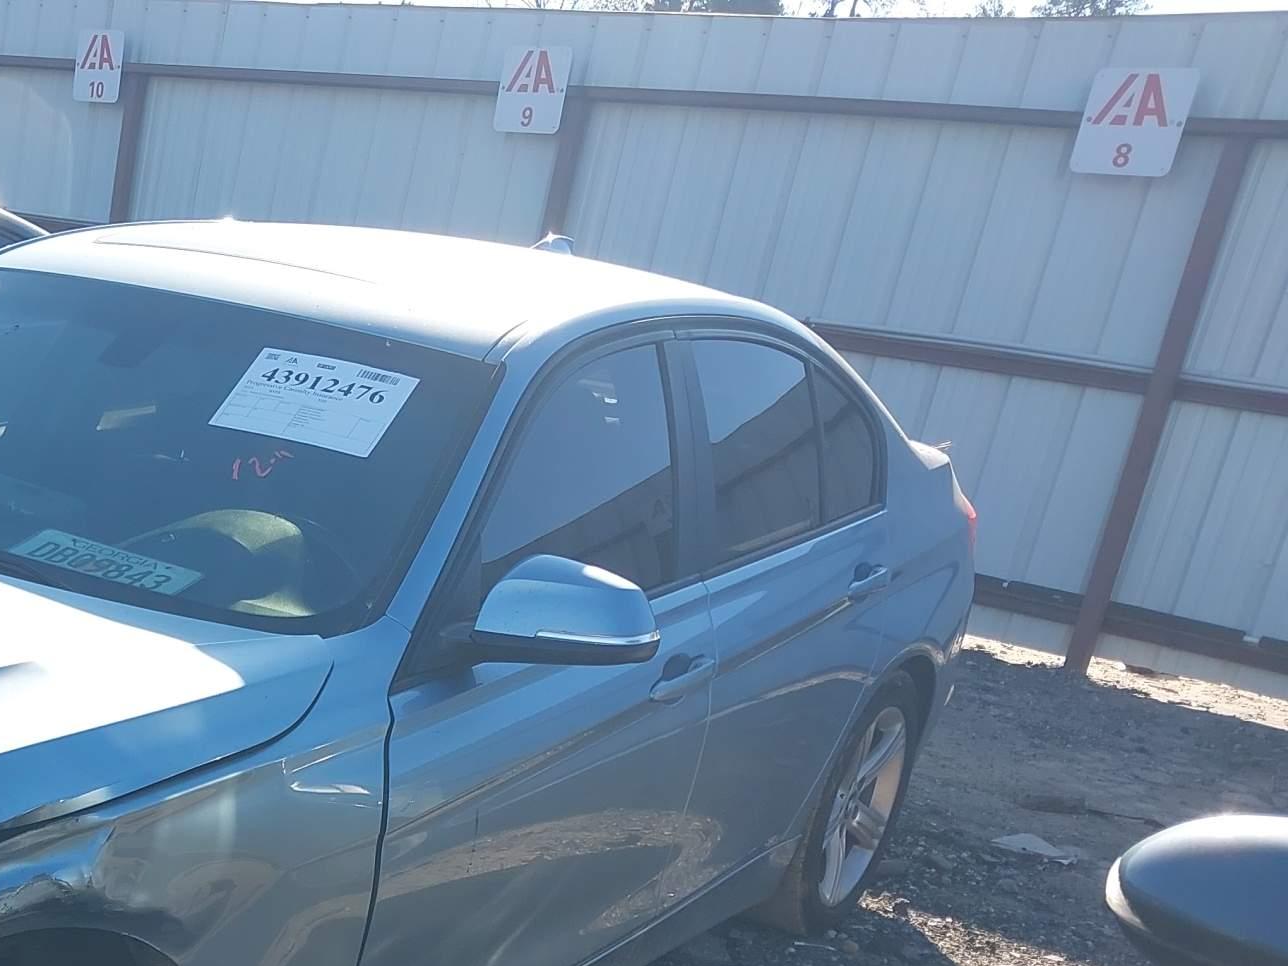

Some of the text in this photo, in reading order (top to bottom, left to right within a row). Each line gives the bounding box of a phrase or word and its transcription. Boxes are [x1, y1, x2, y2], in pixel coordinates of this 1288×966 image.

[89, 81, 105, 98] 10
[520, 106, 534, 128] 9
[1111, 143, 1133, 168] 8
[261, 367, 389, 404] 43912476
[74, 539, 159, 570] GEORGIA
